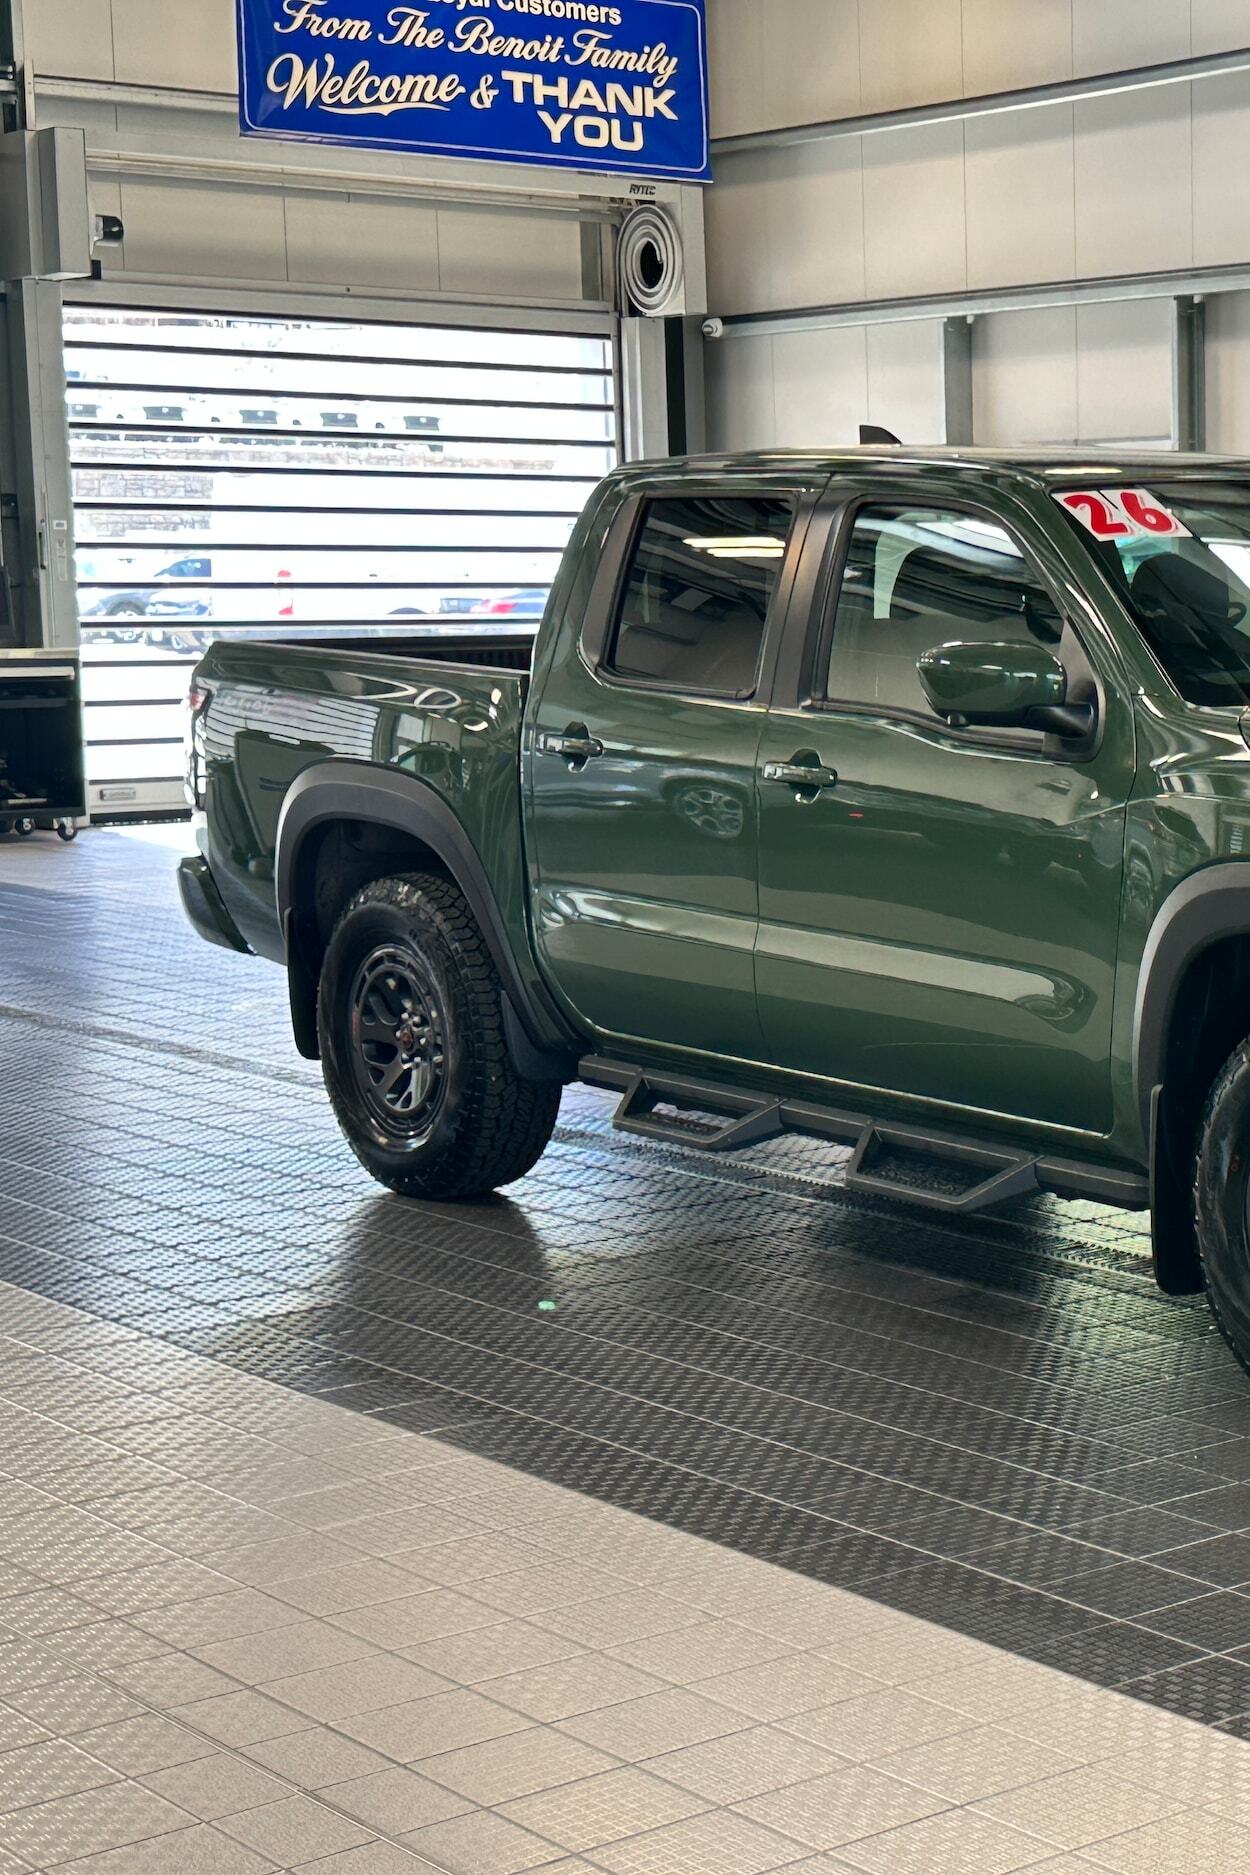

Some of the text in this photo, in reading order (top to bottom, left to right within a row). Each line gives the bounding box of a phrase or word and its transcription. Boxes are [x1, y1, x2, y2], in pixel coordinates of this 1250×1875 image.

[273, 0, 679, 88] From The Benoit Family
[266, 52, 679, 121] Welcome & THANK
[536, 110, 645, 151] YOU
[1062, 491, 1174, 535] 26
